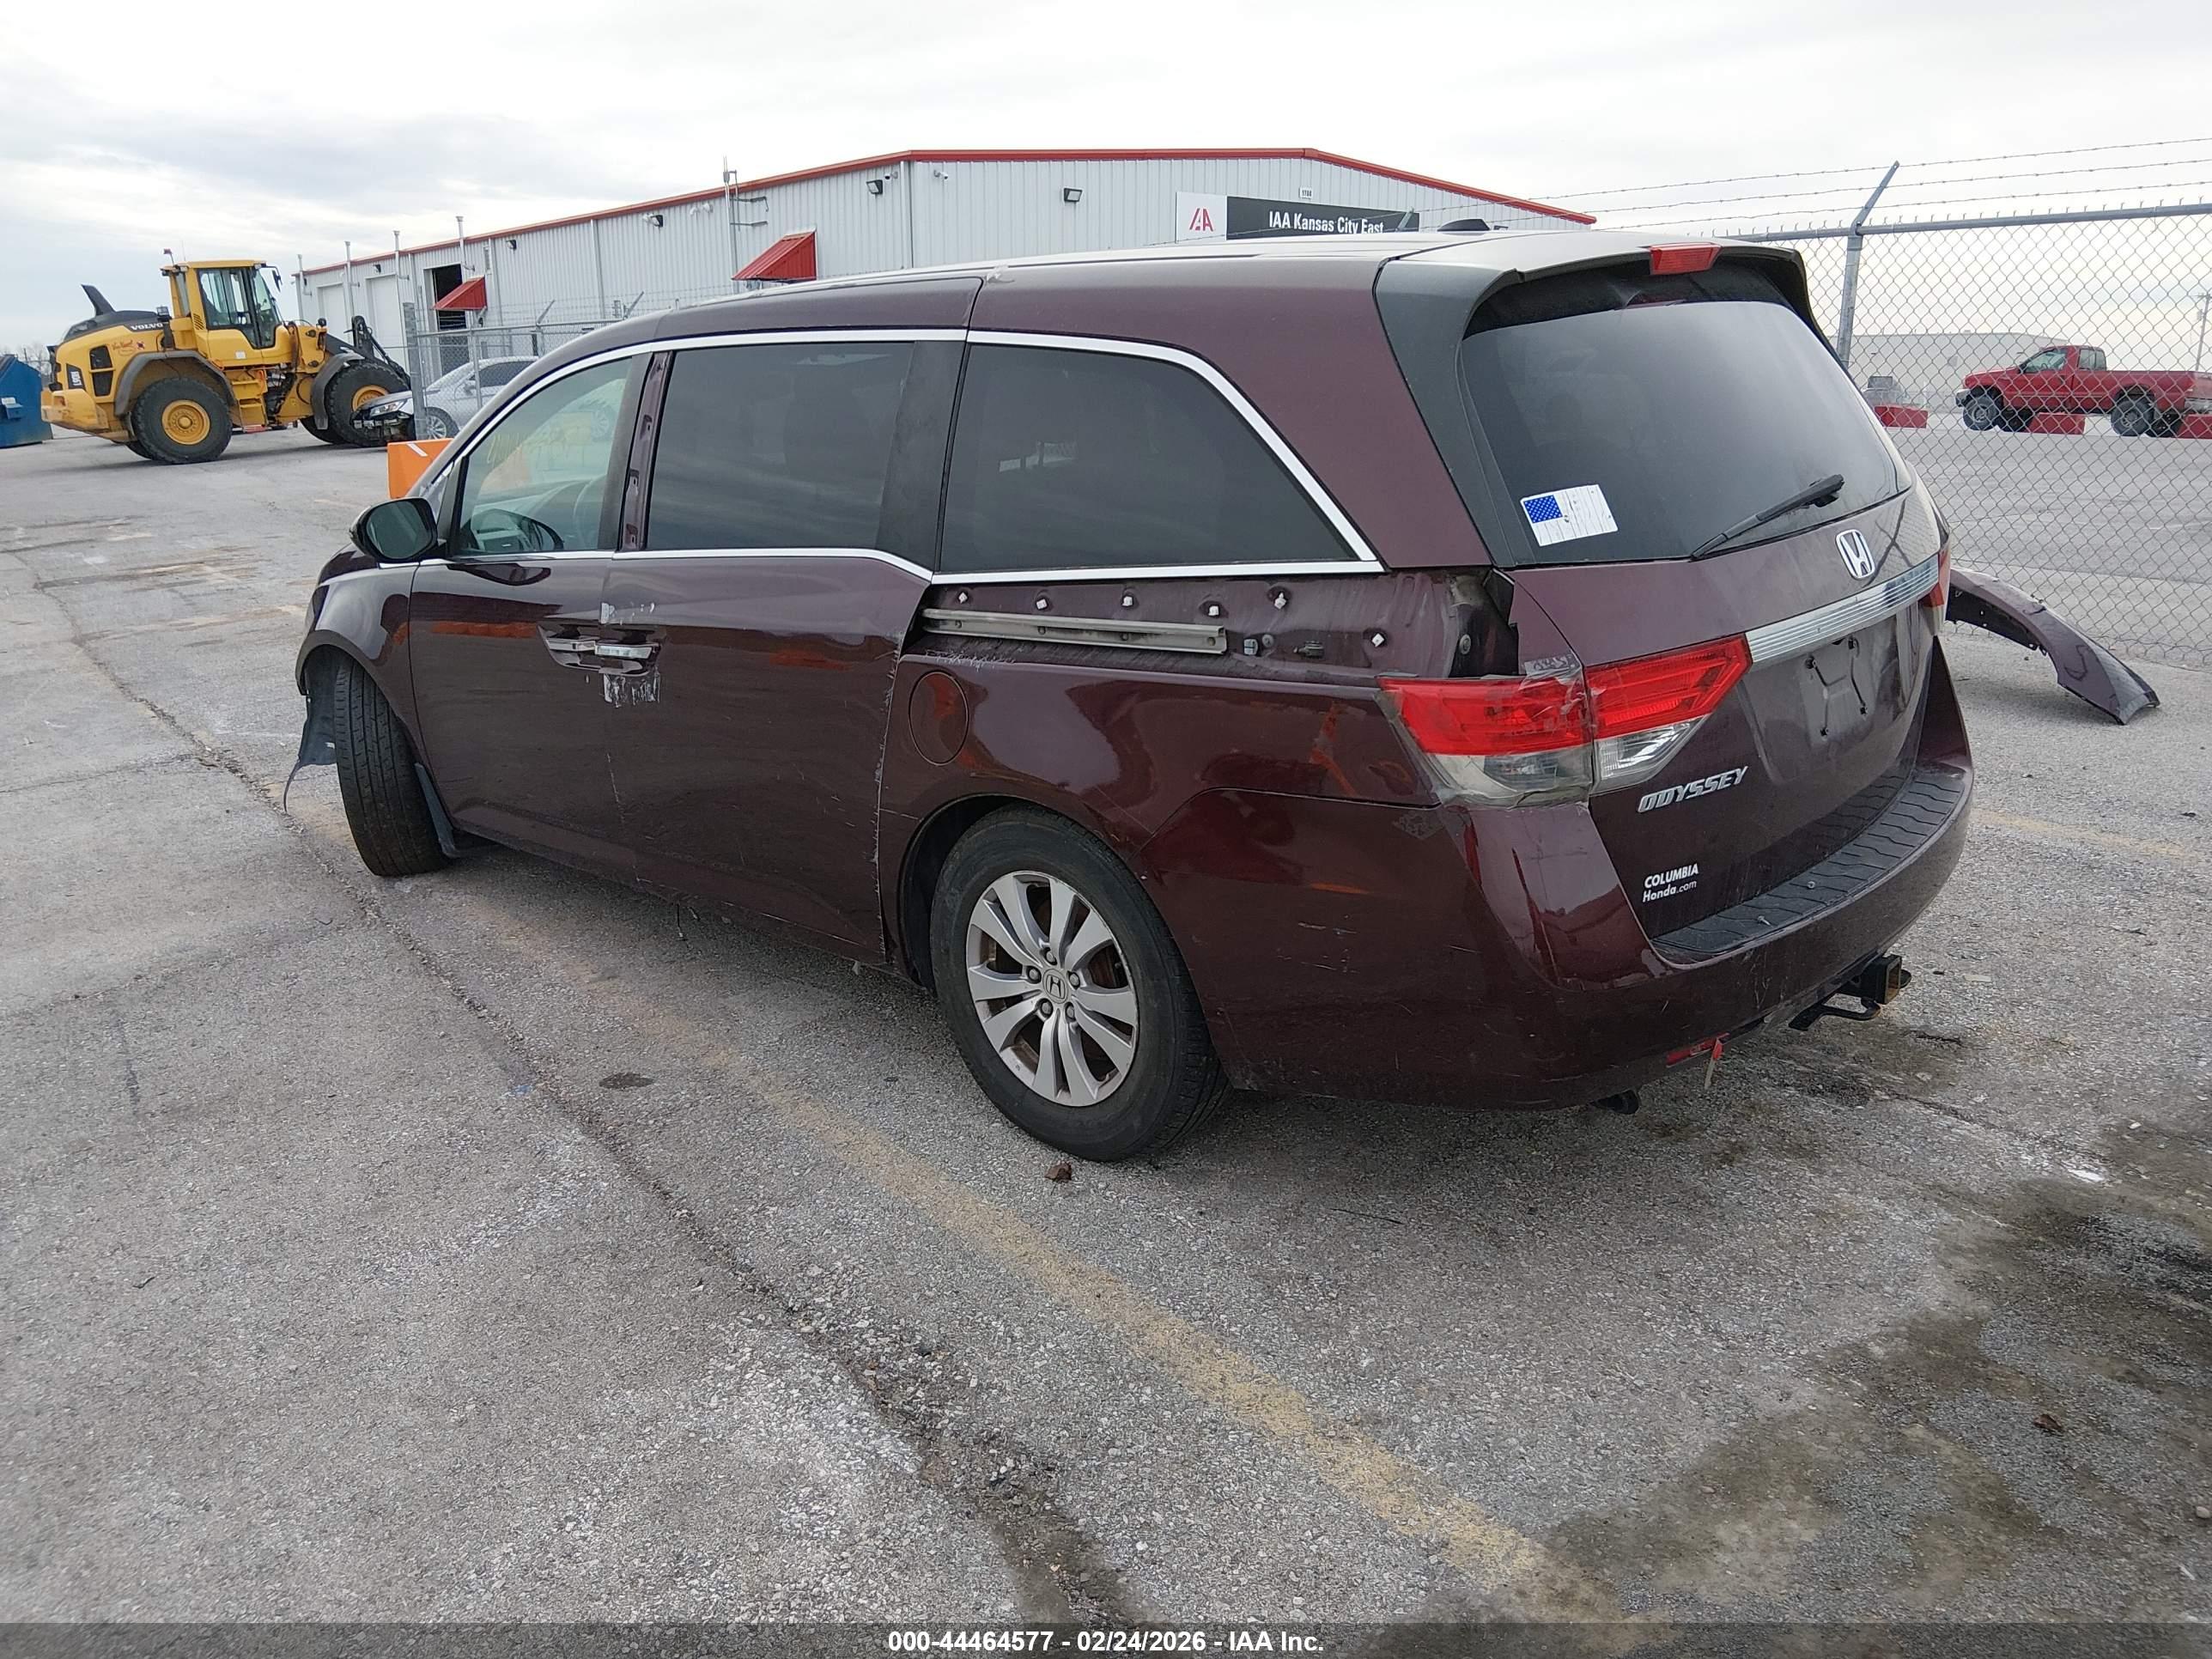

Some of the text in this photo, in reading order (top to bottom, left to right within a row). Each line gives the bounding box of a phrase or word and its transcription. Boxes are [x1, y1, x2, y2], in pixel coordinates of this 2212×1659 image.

[1269, 210, 1384, 234] IAA Kansas City East
[131, 322, 164, 331] VOLVO
[1638, 765, 1748, 813] ODYSSEY
[1644, 863, 1699, 889] COLUMBIA
[1642, 880, 1697, 902] Honda.com
